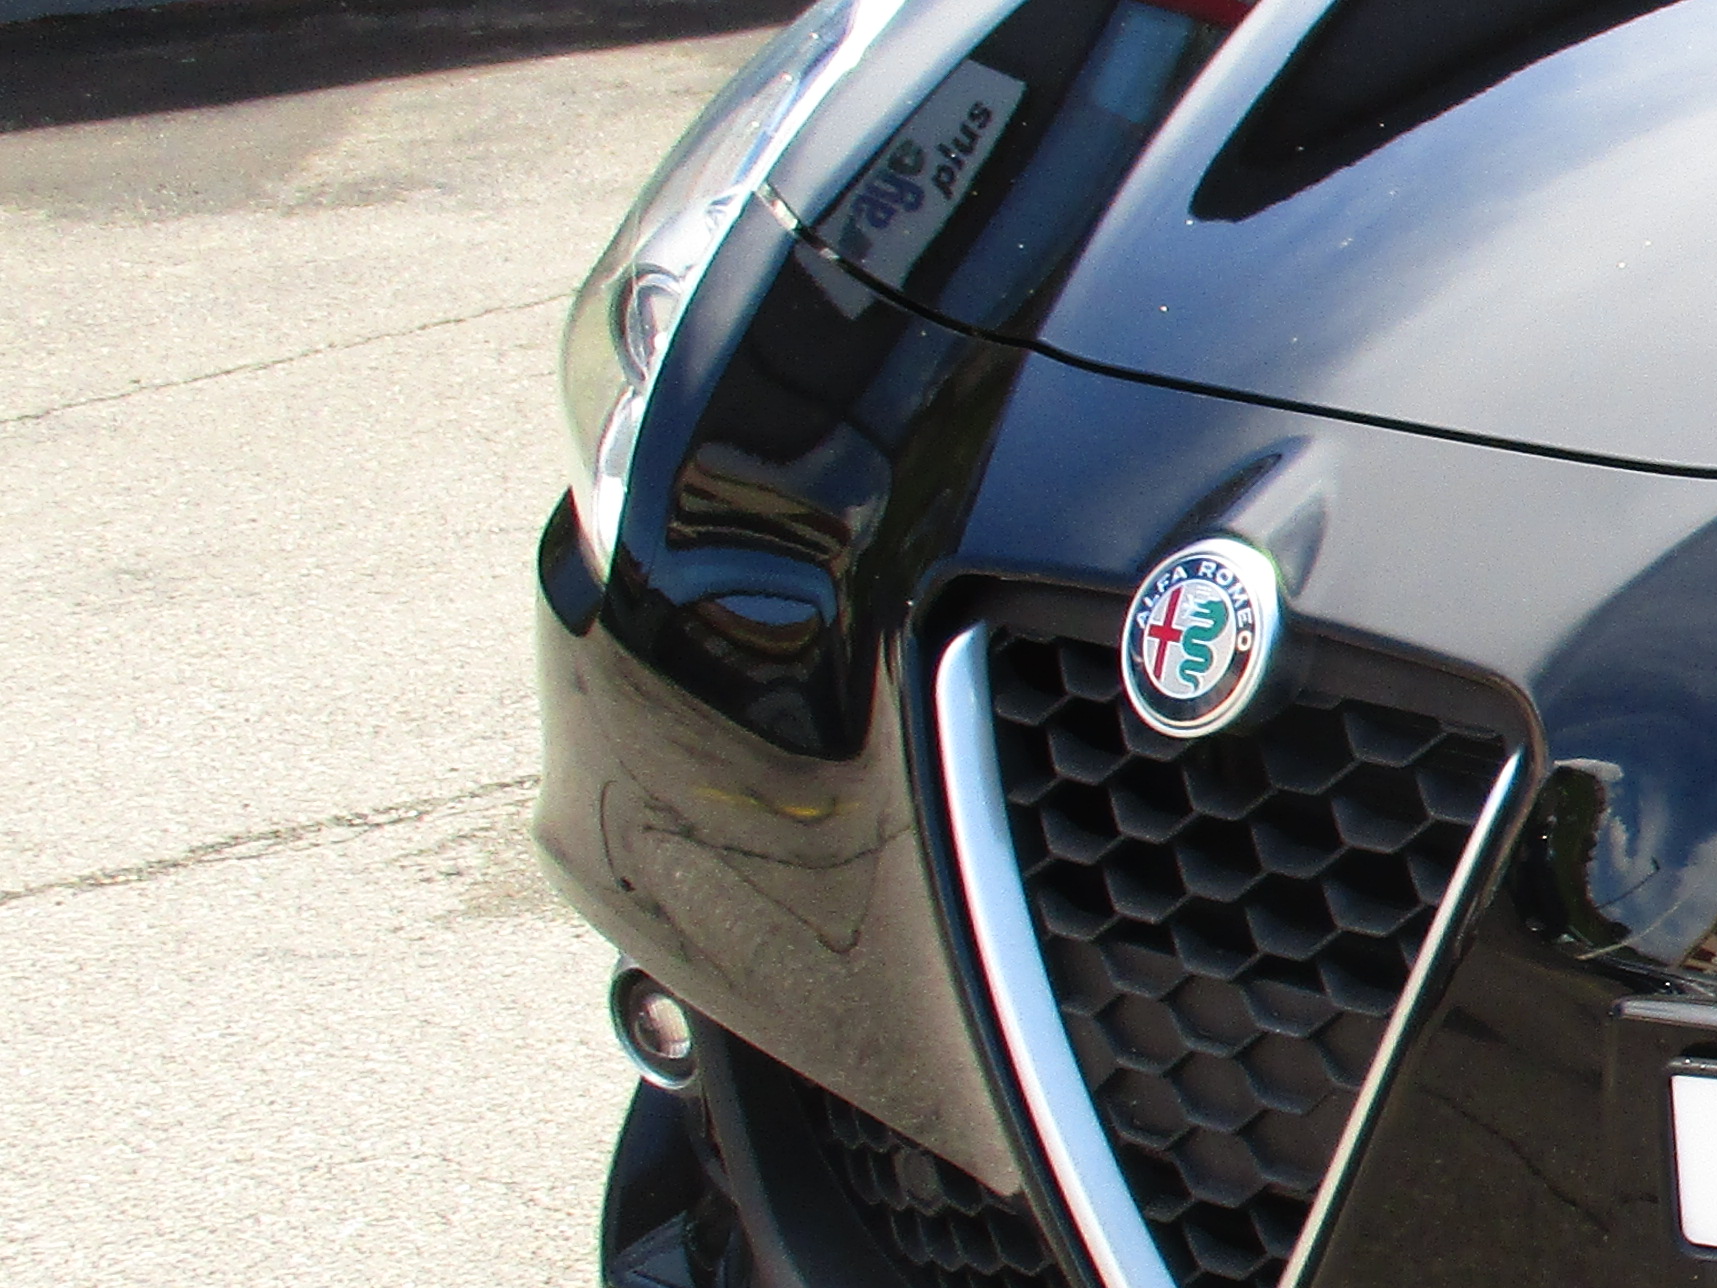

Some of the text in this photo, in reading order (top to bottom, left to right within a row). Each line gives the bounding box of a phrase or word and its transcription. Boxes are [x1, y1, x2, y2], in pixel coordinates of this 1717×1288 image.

[932, 101, 993, 201] plus
[1136, 561, 1253, 652] ALFA ROMEO
